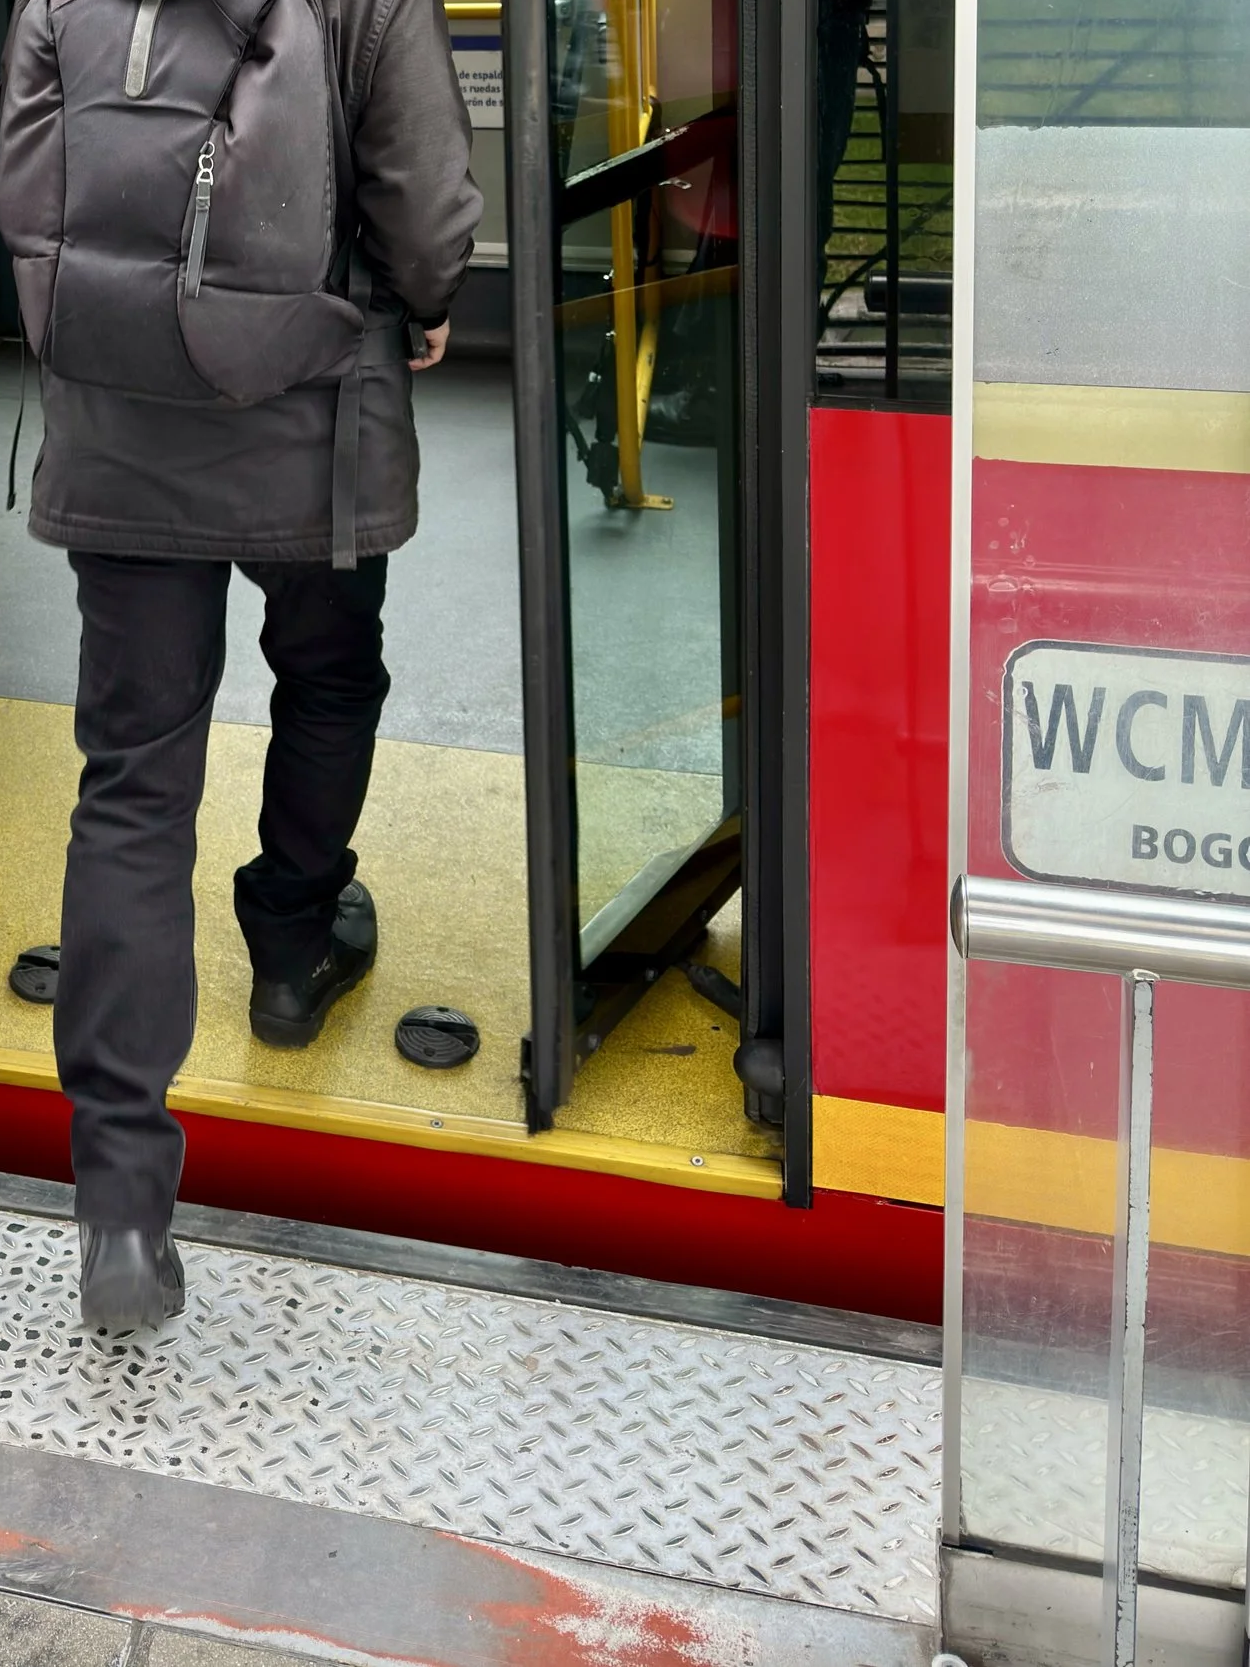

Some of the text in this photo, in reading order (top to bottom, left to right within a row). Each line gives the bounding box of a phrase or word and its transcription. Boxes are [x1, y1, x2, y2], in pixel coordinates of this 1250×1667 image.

[458, 70, 470, 80] de
[469, 83, 502, 93] ruedas
[485, 96, 498, 107] de
